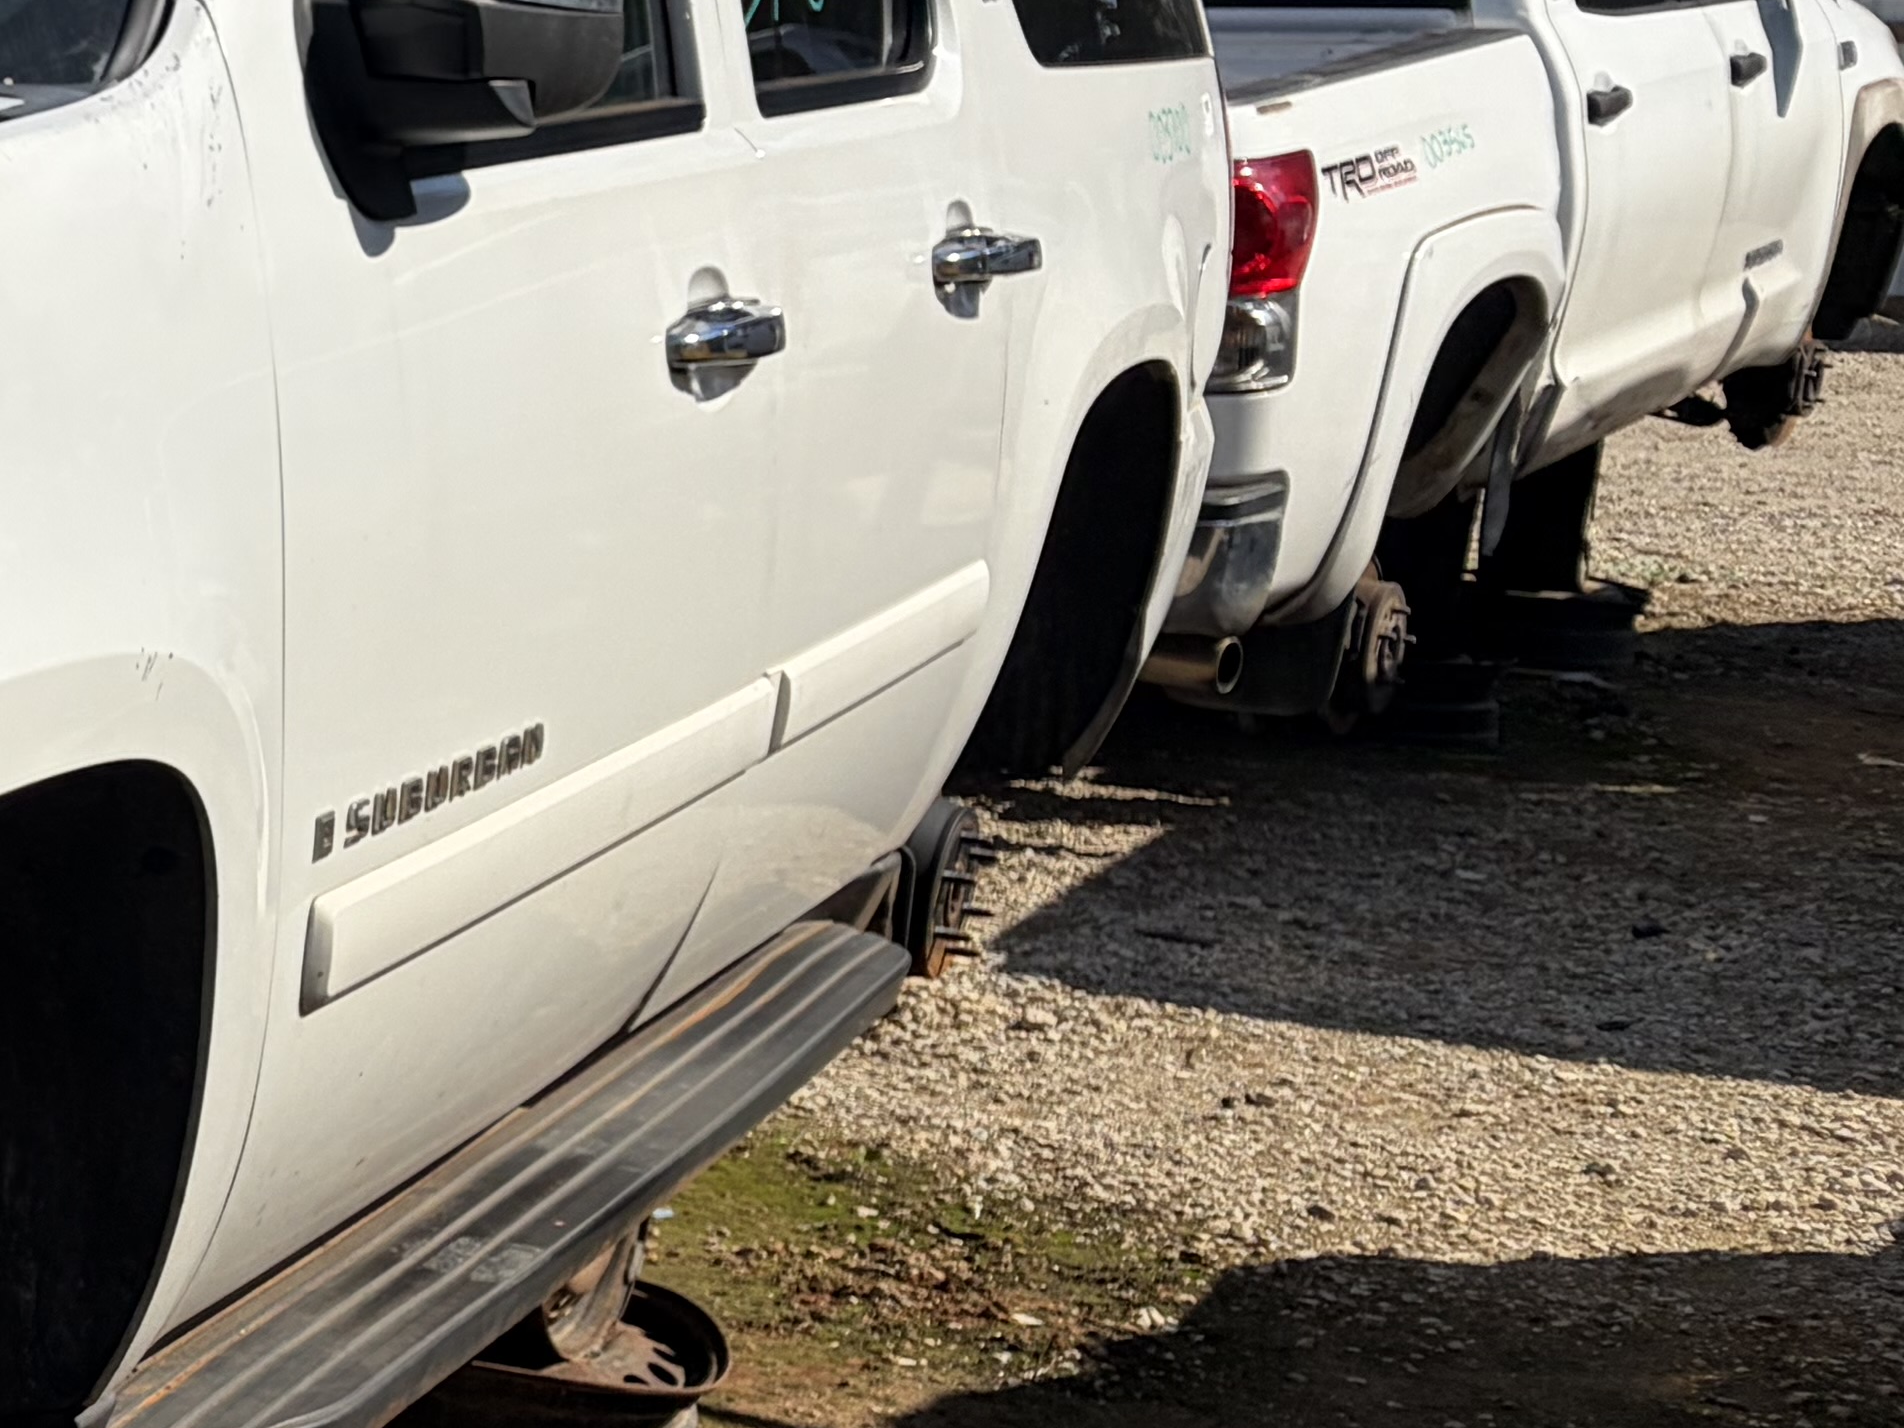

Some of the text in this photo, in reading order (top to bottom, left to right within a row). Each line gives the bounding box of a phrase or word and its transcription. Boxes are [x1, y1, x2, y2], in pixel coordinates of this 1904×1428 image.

[1374, 146, 1399, 163] OFF
[1379, 159, 1415, 180] ROAD
[1322, 154, 1376, 202] TRD
[343, 721, 545, 850] SUBURBAN
